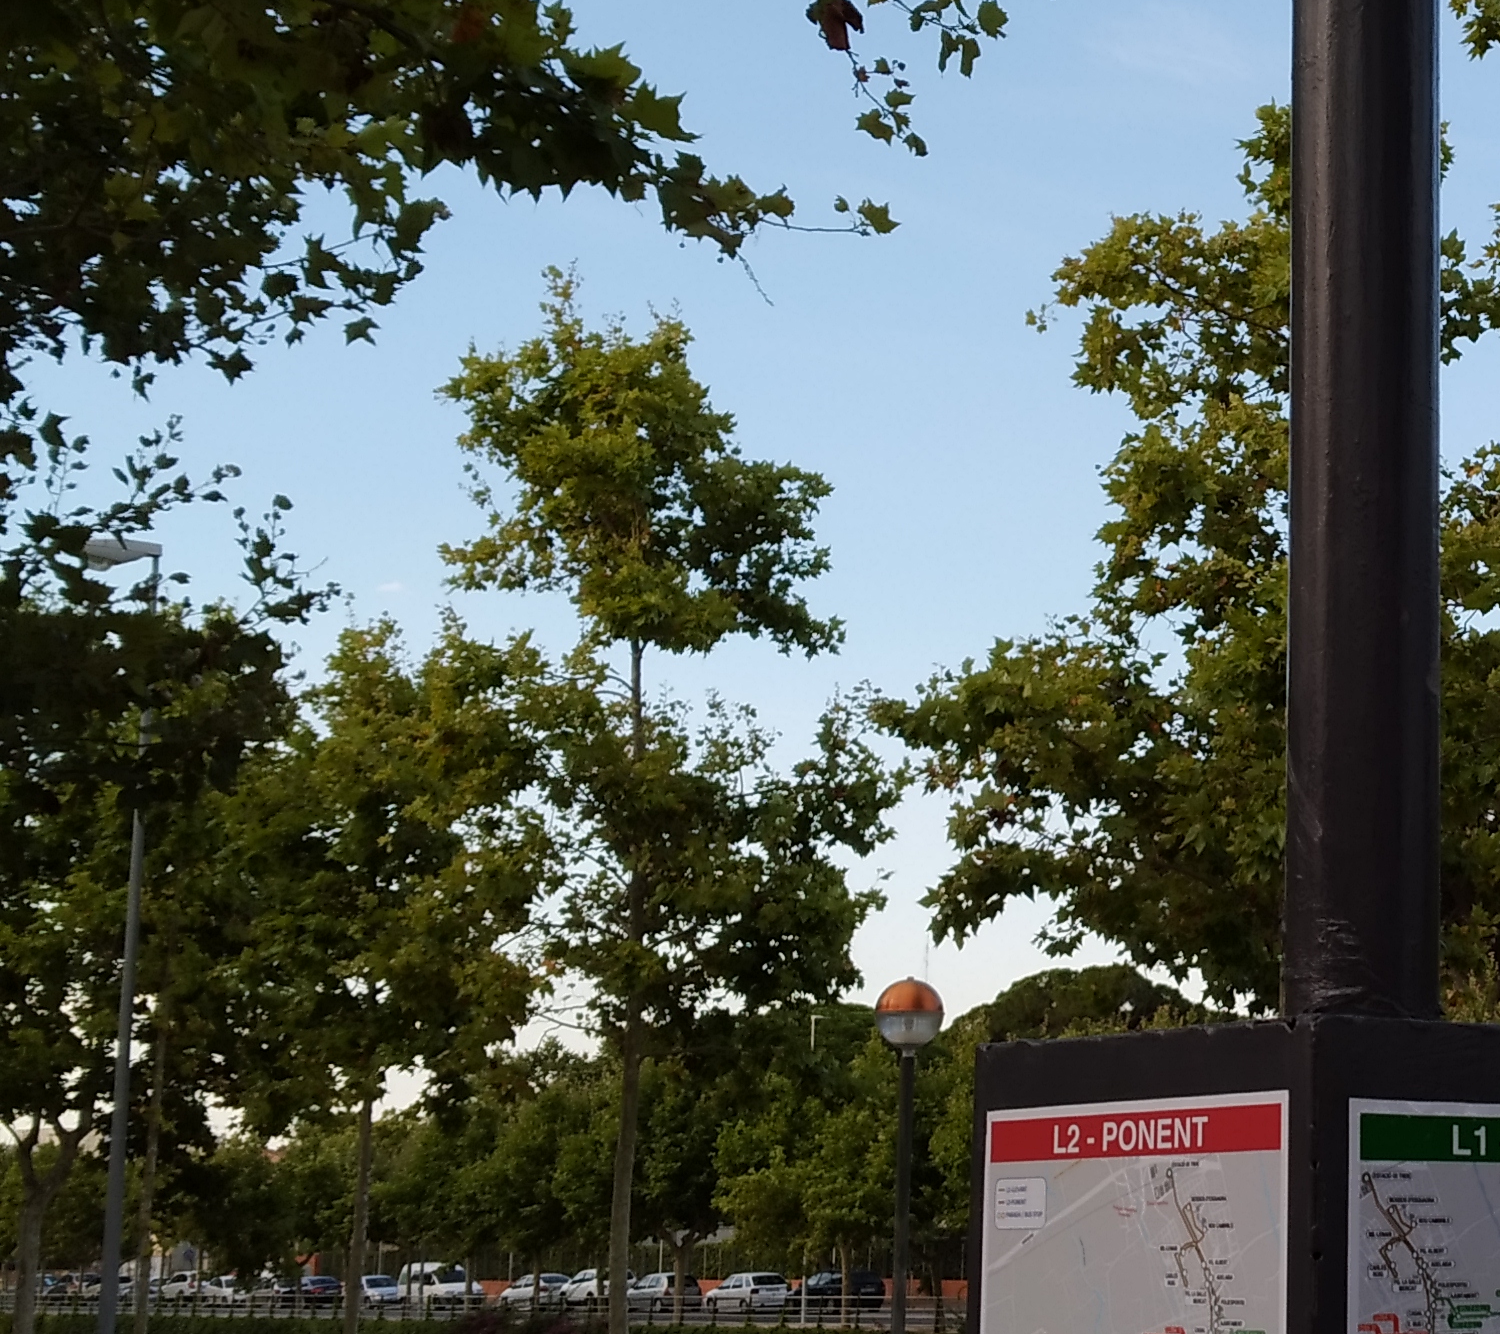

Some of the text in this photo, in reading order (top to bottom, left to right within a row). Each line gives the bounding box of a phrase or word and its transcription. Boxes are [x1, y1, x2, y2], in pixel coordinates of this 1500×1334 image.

[1052, 1123, 1080, 1153] L2
[1102, 1115, 1208, 1151] PONENT
[1452, 1123, 1486, 1155] L1
